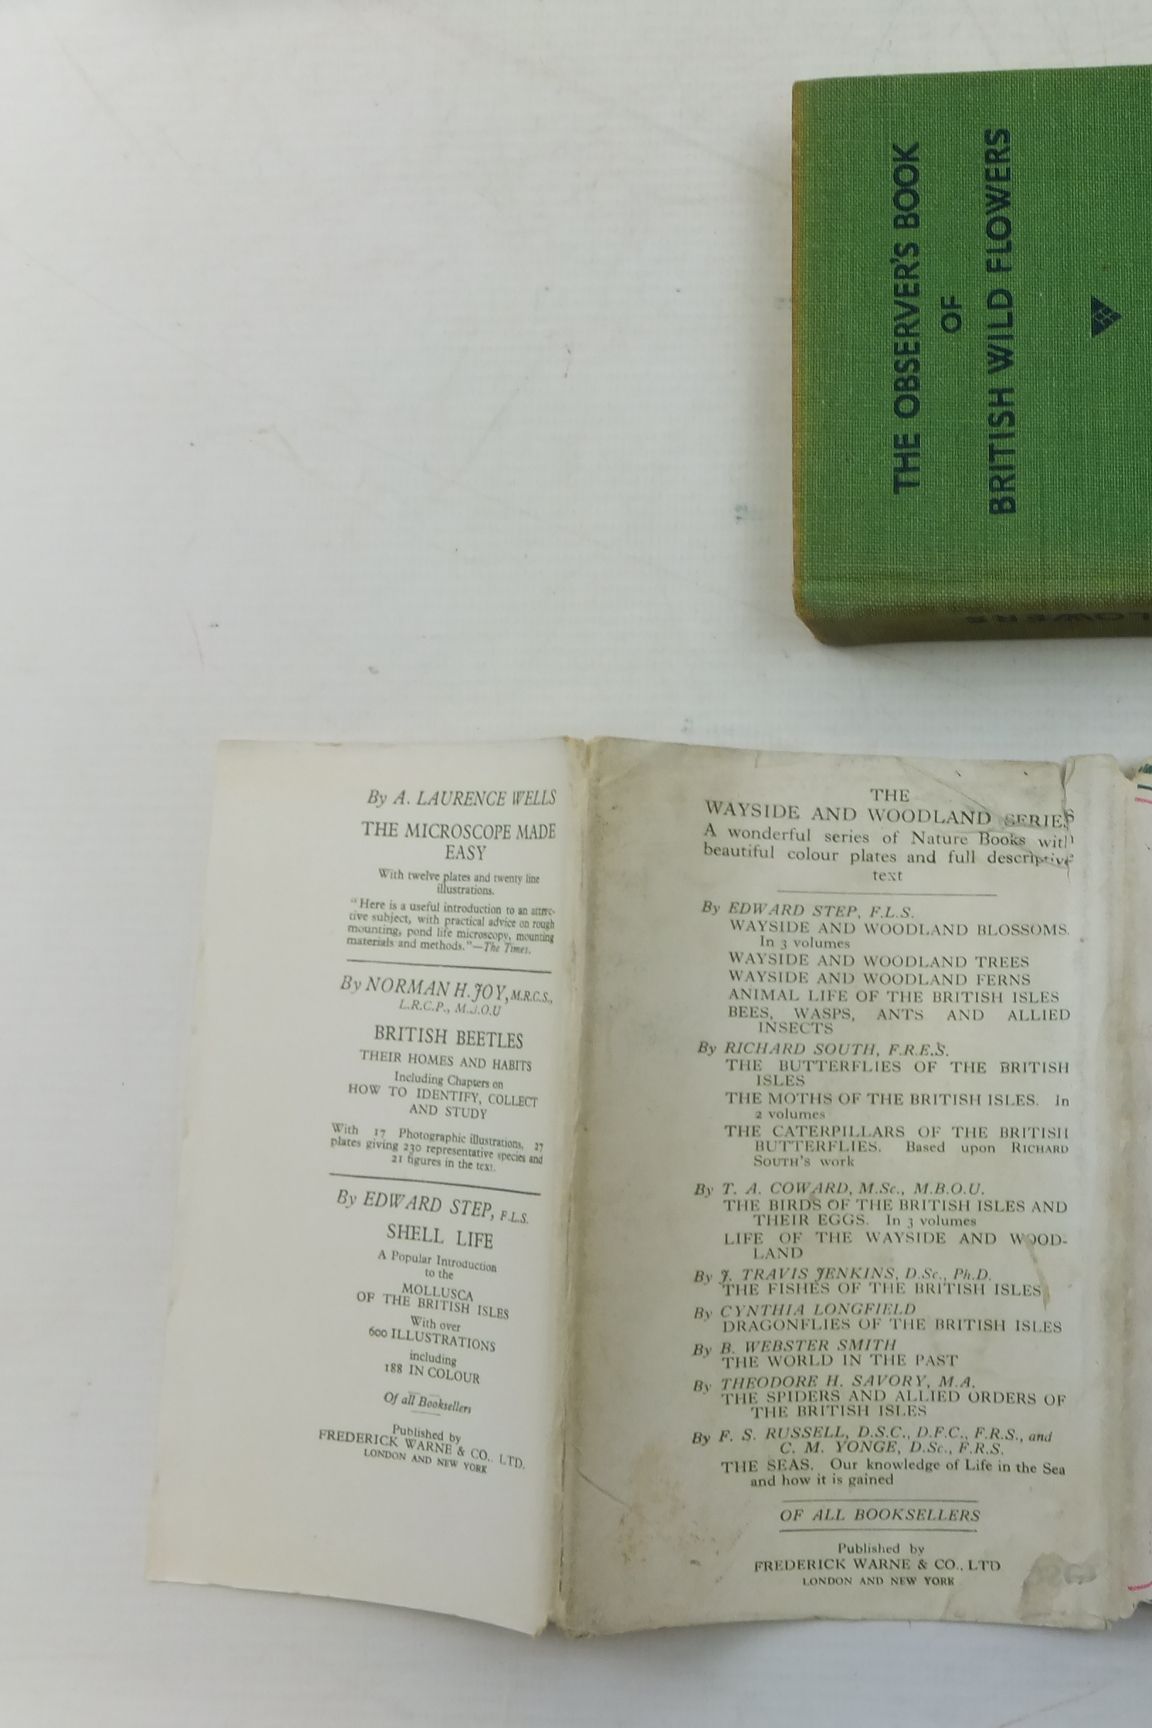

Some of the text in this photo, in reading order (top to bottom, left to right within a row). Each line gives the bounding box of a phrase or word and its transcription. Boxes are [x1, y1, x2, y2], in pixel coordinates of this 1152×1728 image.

[889, 141, 921, 495] THE OBSERVER'S BOOK
[940, 295, 963, 334] OF
[984, 127, 1017, 515] BRITISH WILD FLOWERS
[366, 788, 557, 809] By A. LAURENCE WELLS
[869, 787, 910, 803] THE
[704, 799, 801, 820] WAYSIDE
[810, 806, 858, 822] AND
[867, 807, 992, 825] WOODLAND
[360, 820, 557, 841] THE MICROSCOPE MADE
[444, 844, 487, 862] EASY
[700, 899, 915, 920] By EDWARD STEP, F.L.S.
[728, 950, 1030, 969] WAYSIDE AND WOODLAND TREES
[728, 987, 1060, 1004] ANIMAL LIFE OF THE BRITISH ISLES
[373, 1024, 524, 1050] BRITISH BEETLES
[359, 1048, 533, 1073] THEIR HOMES AND HABITS
[386, 1222, 494, 1250] SHELL LIFE
[401, 1282, 475, 1303] MOLLUSCA
[356, 1290, 510, 1321] OF THE BRITISH ISLES
[722, 1317, 1063, 1334] DRAGONFLIES OF THE BRITISH ISLES
[721, 1353, 959, 1370] THE WORLD IN THE PAST
[363, 1448, 488, 1475] LONDON AND NEW YORK
[779, 1507, 981, 1523] OF ALL BOOKSELLERS
[754, 1557, 1002, 1573] FREDERICK WARNE & CO., LTD
